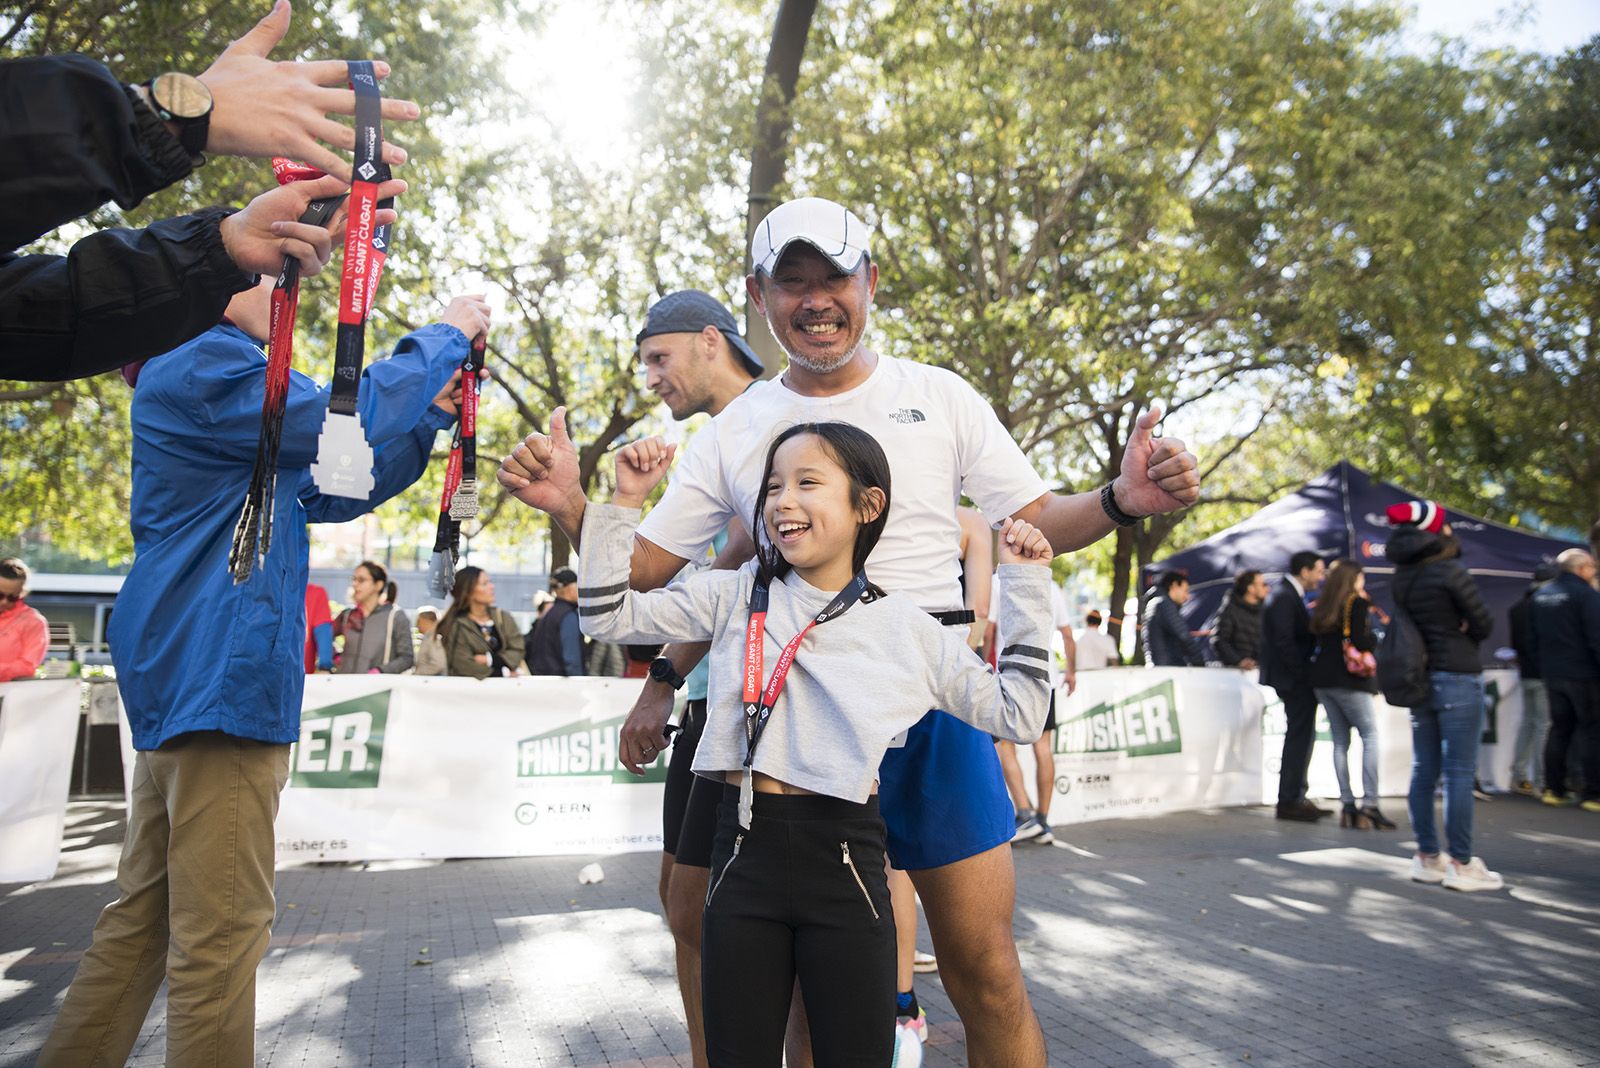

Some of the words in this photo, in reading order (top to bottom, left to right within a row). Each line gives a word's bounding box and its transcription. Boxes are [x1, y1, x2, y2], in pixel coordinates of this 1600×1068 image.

[359, 195, 372, 240] CUGAT
[355, 241, 368, 275] SANT
[352, 278, 364, 313] MITJA
[748, 643, 756, 664] SANT
[779, 647, 792, 668] SANT
[747, 664, 755, 694] CUGAT
[767, 668, 782, 698] CUGAT
[1057, 694, 1172, 753] FINISHER
[547, 803, 591, 814] KERN
[276, 838, 349, 851] nisher.es
